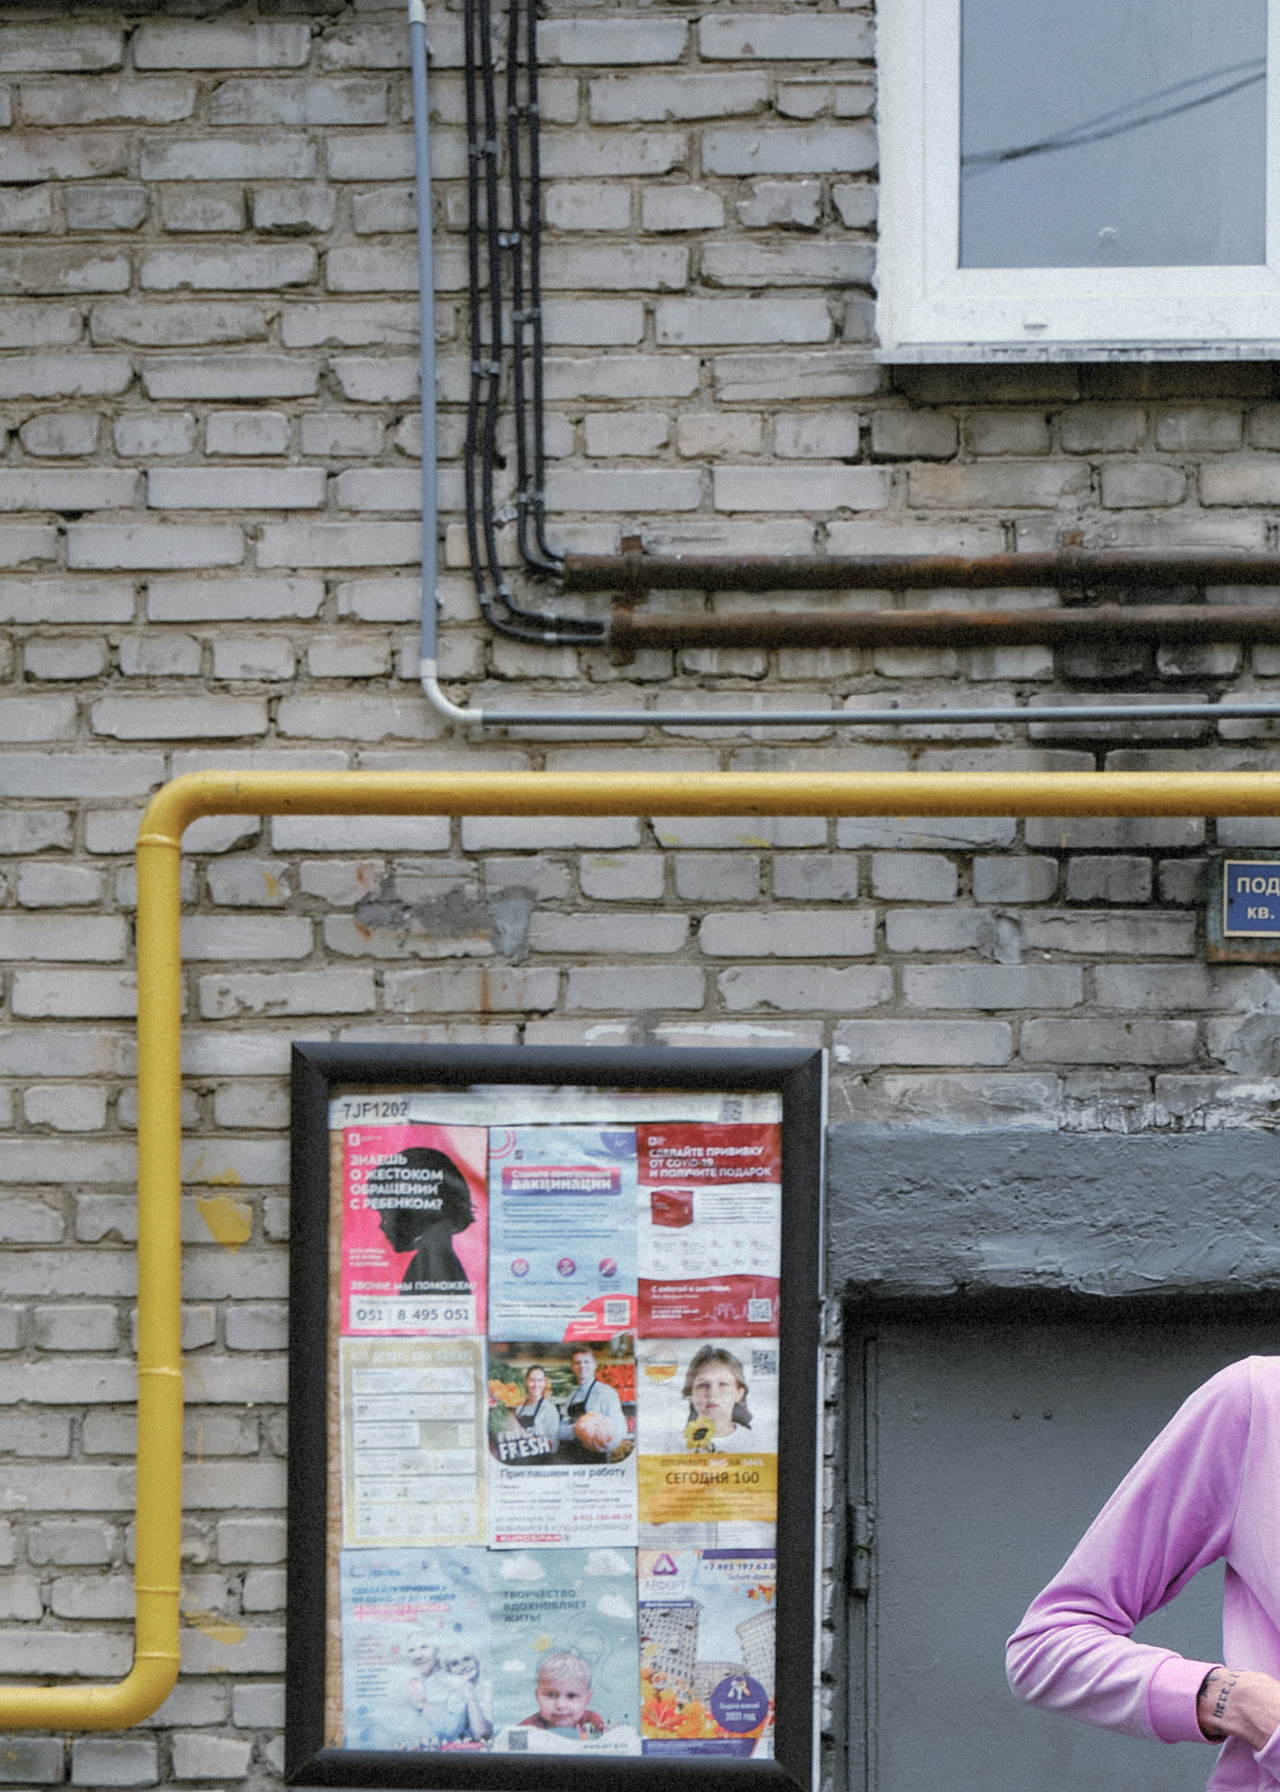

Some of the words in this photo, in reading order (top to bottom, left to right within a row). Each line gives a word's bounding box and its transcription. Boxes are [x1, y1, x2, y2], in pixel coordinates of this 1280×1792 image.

[1247, 906, 1275, 919] кв.
[350, 1153, 408, 1166] ЗНАЕШЬ
[350, 1168, 362, 1181] О
[364, 1167, 444, 1181] ЖЕСТОКОМ
[350, 1182, 439, 1195] ОБРАЩЕНИИ
[350, 1197, 361, 1210] С
[356, 1309, 383, 1321] 051
[397, 1309, 407, 1321] 8
[412, 1309, 439, 1321] 495
[444, 1309, 470, 1321] 051
[499, 1436, 551, 1461] FRESH
[665, 1471, 729, 1485] СЕГОДНЯ
[735, 1471, 760, 1484] 100
